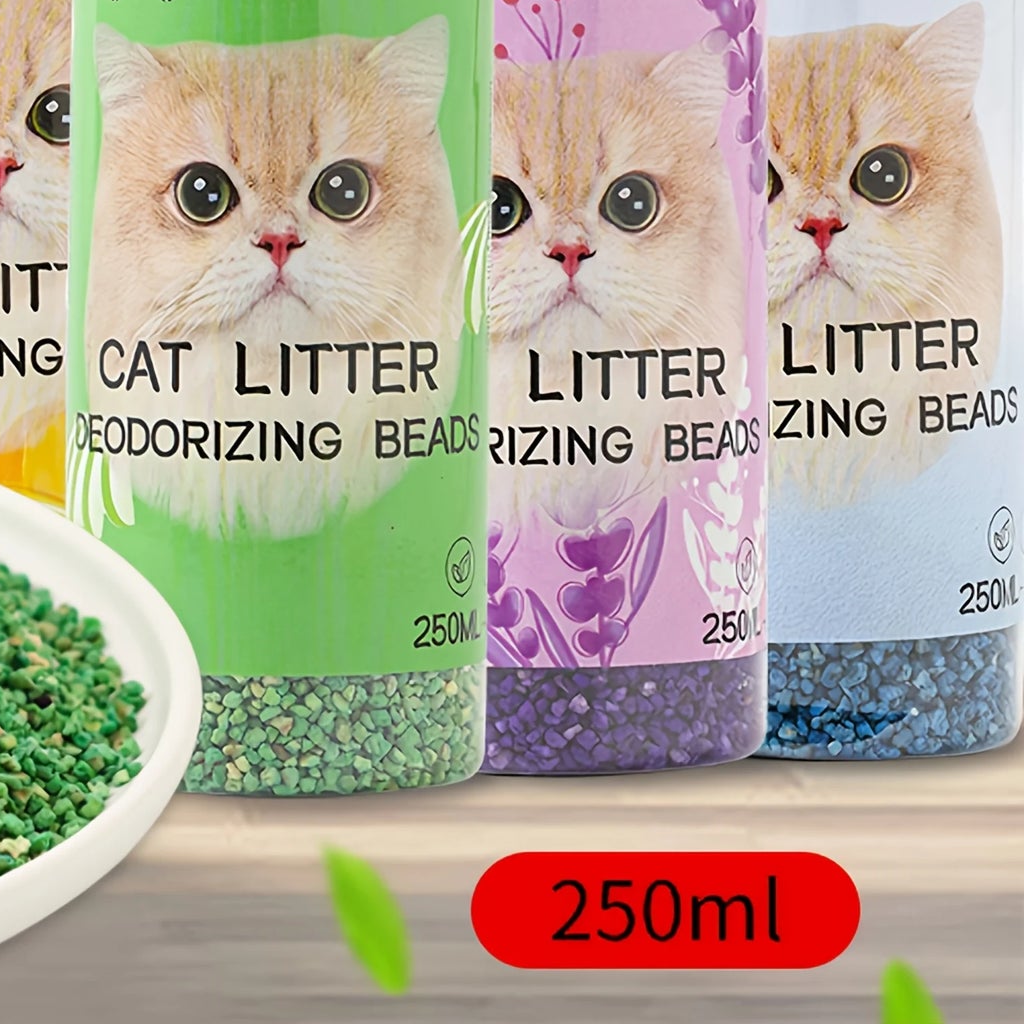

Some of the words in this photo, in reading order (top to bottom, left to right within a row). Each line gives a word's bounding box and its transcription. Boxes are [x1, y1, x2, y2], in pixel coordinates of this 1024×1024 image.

[99, 338, 193, 393] CAT
[235, 341, 439, 396] LITTER
[781, 318, 979, 376] LITTER
[528, 346, 726, 403] LITTER
[76, 412, 343, 462] DEODORIZING
[375, 413, 480, 459] BEADS
[919, 387, 1018, 434] BEADS
[664, 418, 761, 463] BEADS
